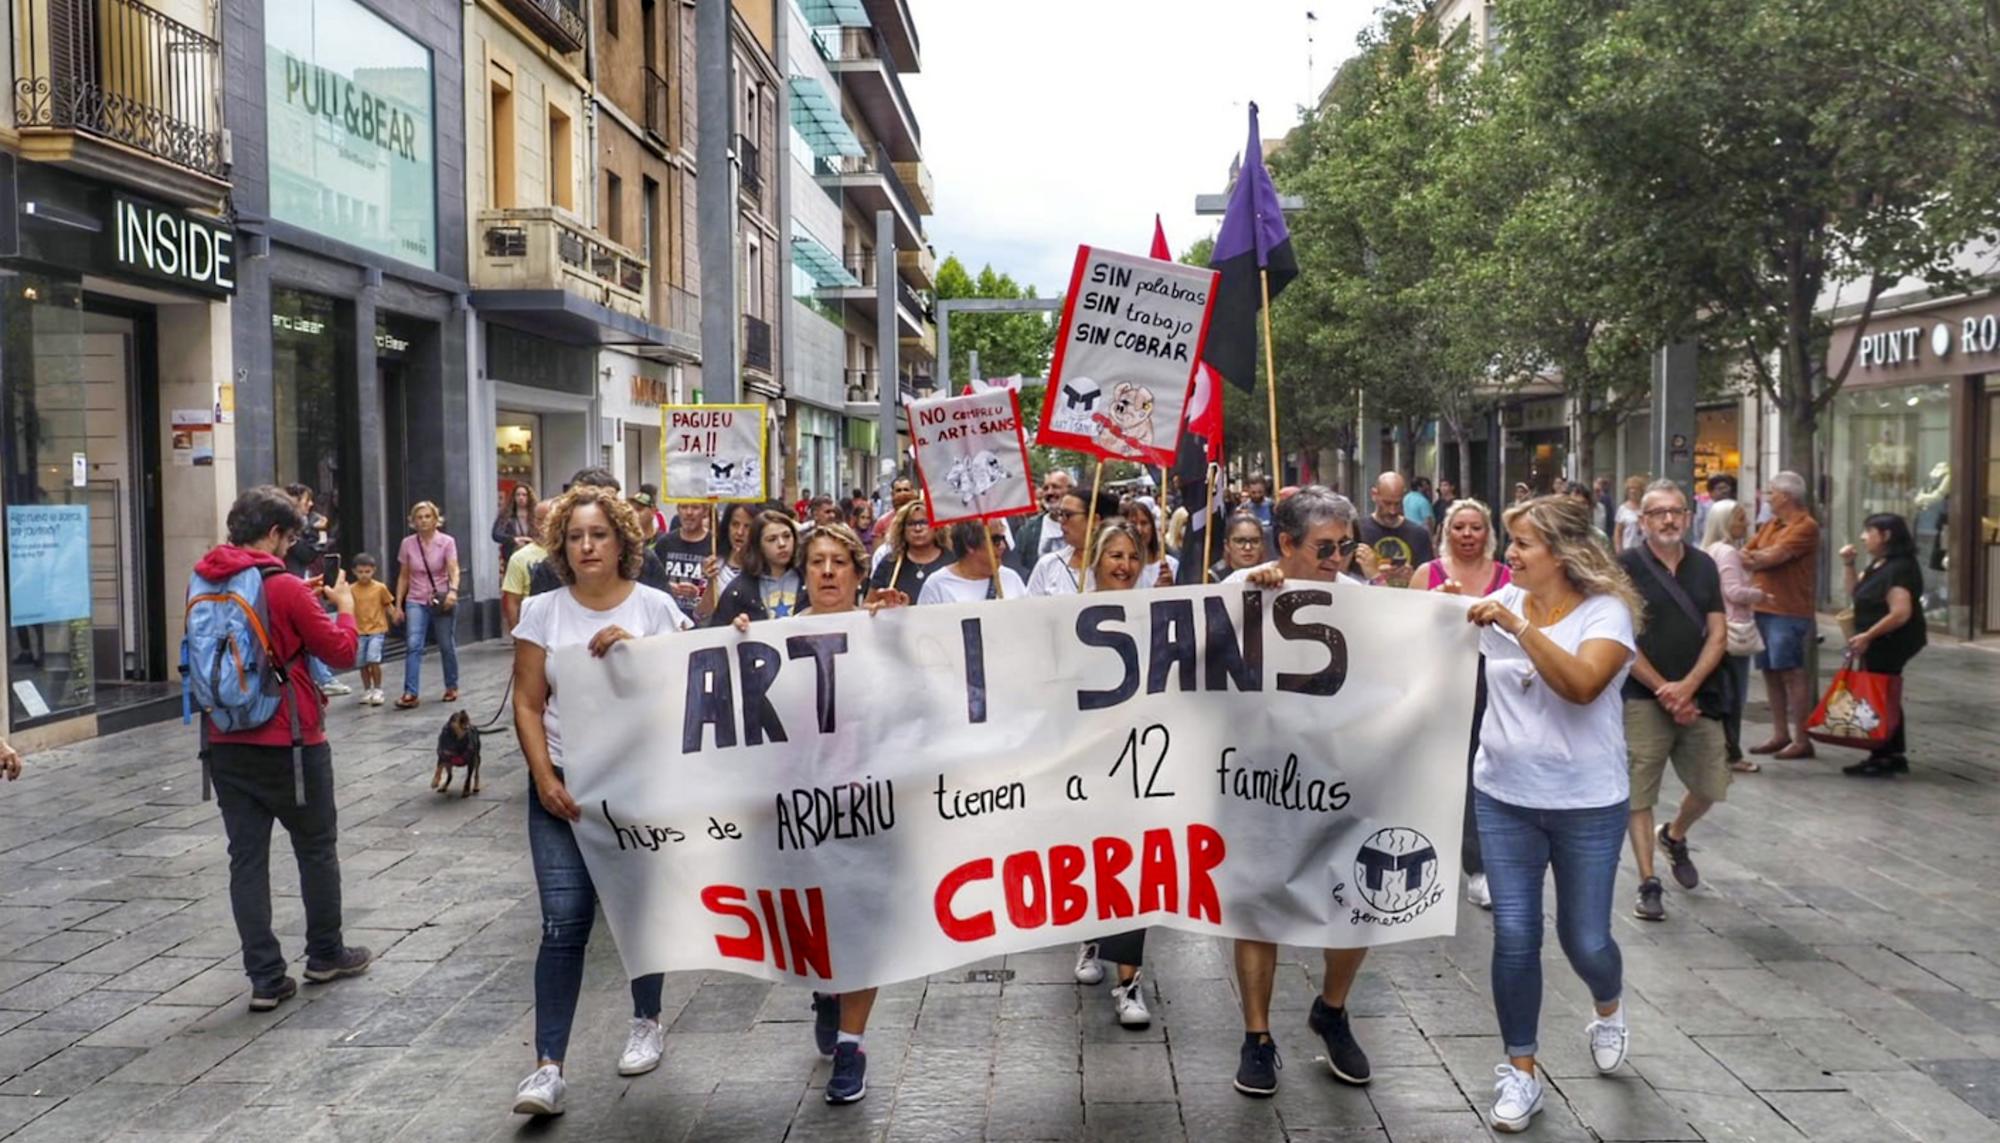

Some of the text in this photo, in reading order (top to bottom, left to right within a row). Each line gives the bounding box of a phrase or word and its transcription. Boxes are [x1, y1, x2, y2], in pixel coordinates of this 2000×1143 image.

[117, 200, 234, 289] INSIDE
[1091, 263, 1206, 306] SIN palabras
[1075, 323, 1110, 345] SIN
[1083, 292, 1193, 339] SIN trabajo
[1860, 314, 2000, 367] PUNT RO
[672, 411, 732, 428] PAGUEU
[919, 407, 946, 426] NO
[938, 425, 968, 442] ART
[979, 417, 1017, 435] SANS
[666, 561, 701, 579] PAPA
[682, 589, 1348, 754] ART I SANS
[602, 800, 686, 851] hijos
[708, 818, 742, 840] de
[934, 774, 1026, 820] tienen
[1067, 775, 1087, 800] a
[1109, 724, 1175, 798] 12
[1216, 748, 1351, 812] familias
[701, 824, 1226, 980] SIN COBRAR
